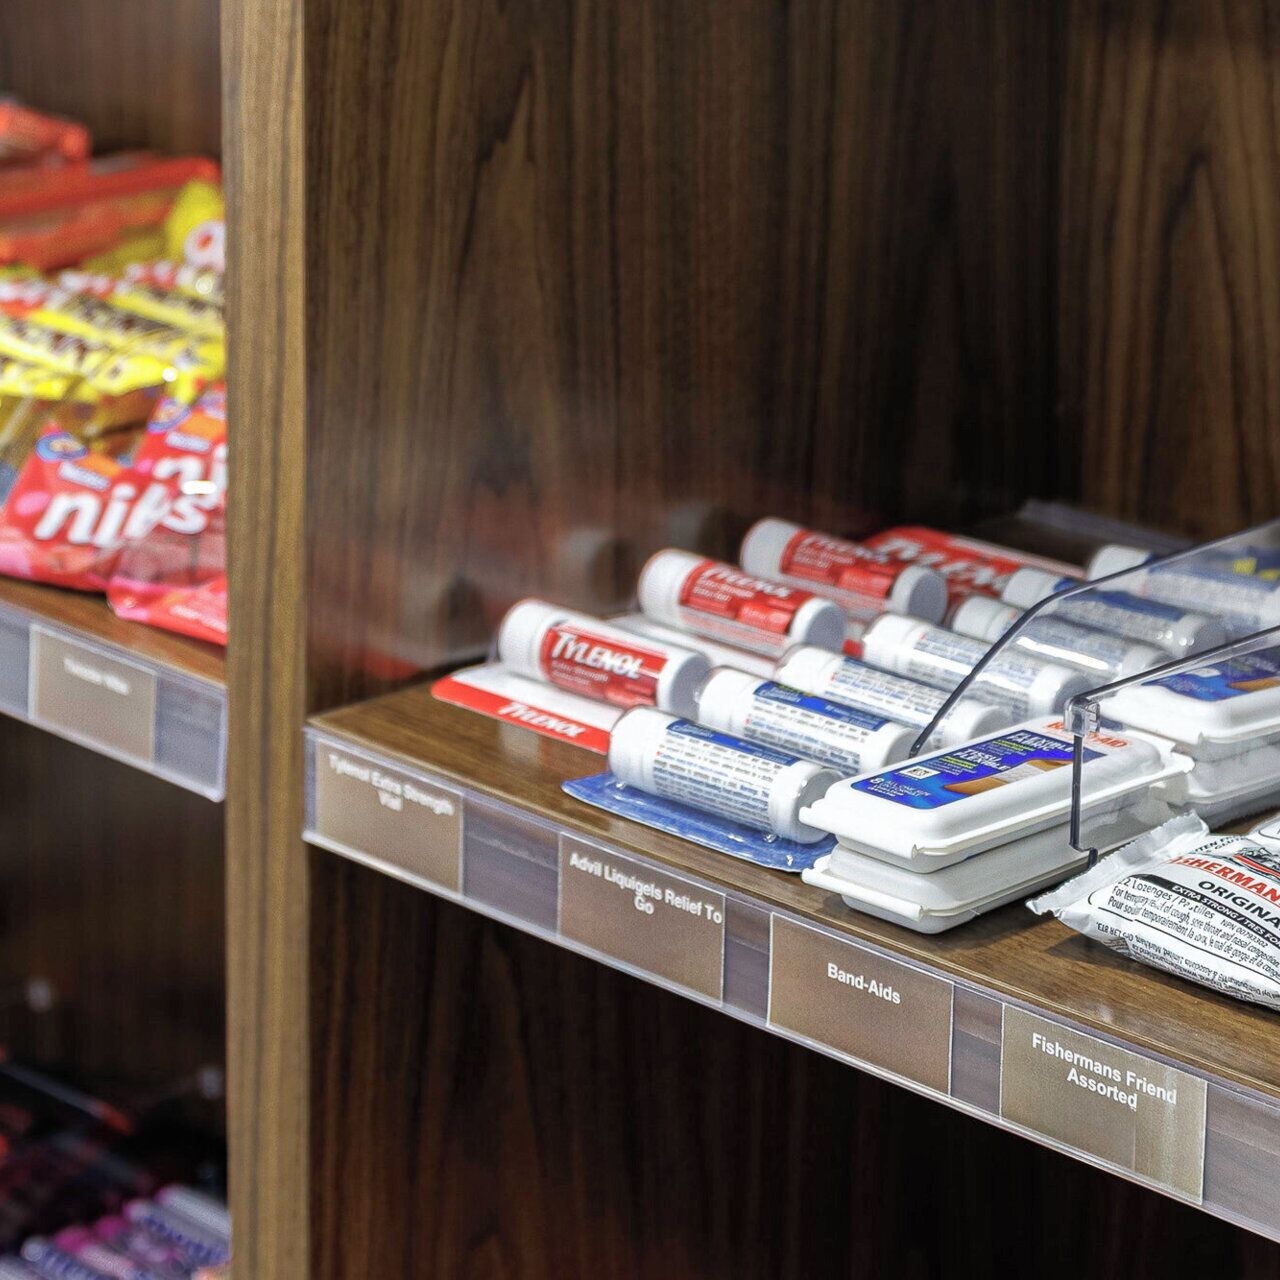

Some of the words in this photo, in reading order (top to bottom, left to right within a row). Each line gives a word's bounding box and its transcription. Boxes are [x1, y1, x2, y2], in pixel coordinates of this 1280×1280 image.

[551, 630, 645, 680] TYLENOL
[569, 852, 602, 878] Advil
[604, 864, 663, 903] Liquigels
[664, 888, 703, 919] Relief
[704, 904, 724, 926] To
[633, 895, 655, 916] Go
[1131, 878, 1174, 902] Lozenges
[1171, 884, 1202, 902] EXTRA
[827, 962, 902, 1006] Band-Aids
[1032, 1032, 1123, 1083] Fishermans
[1125, 1070, 1178, 1106] Friend
[1066, 1067, 1139, 1111] Assorted
